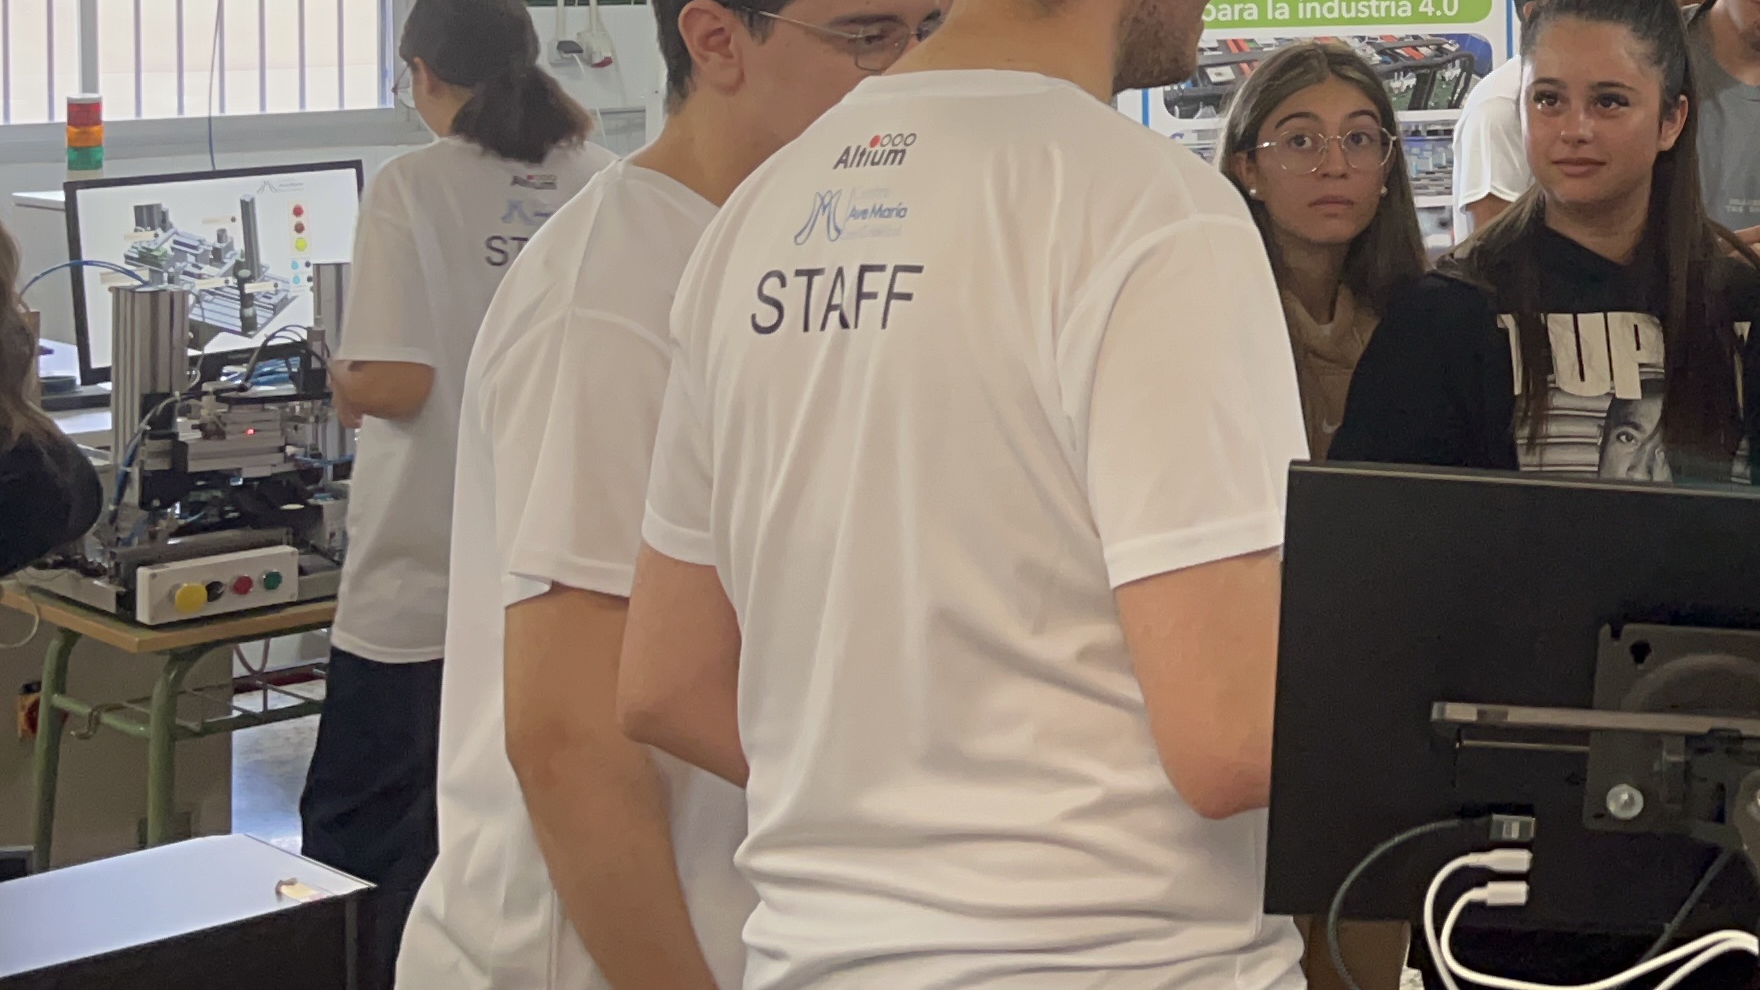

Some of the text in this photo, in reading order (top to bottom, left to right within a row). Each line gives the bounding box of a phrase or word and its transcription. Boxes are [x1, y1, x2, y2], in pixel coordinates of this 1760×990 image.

[833, 145, 907, 170] Altium
[751, 264, 924, 335] STAFF
[1497, 311, 1666, 400] UP
